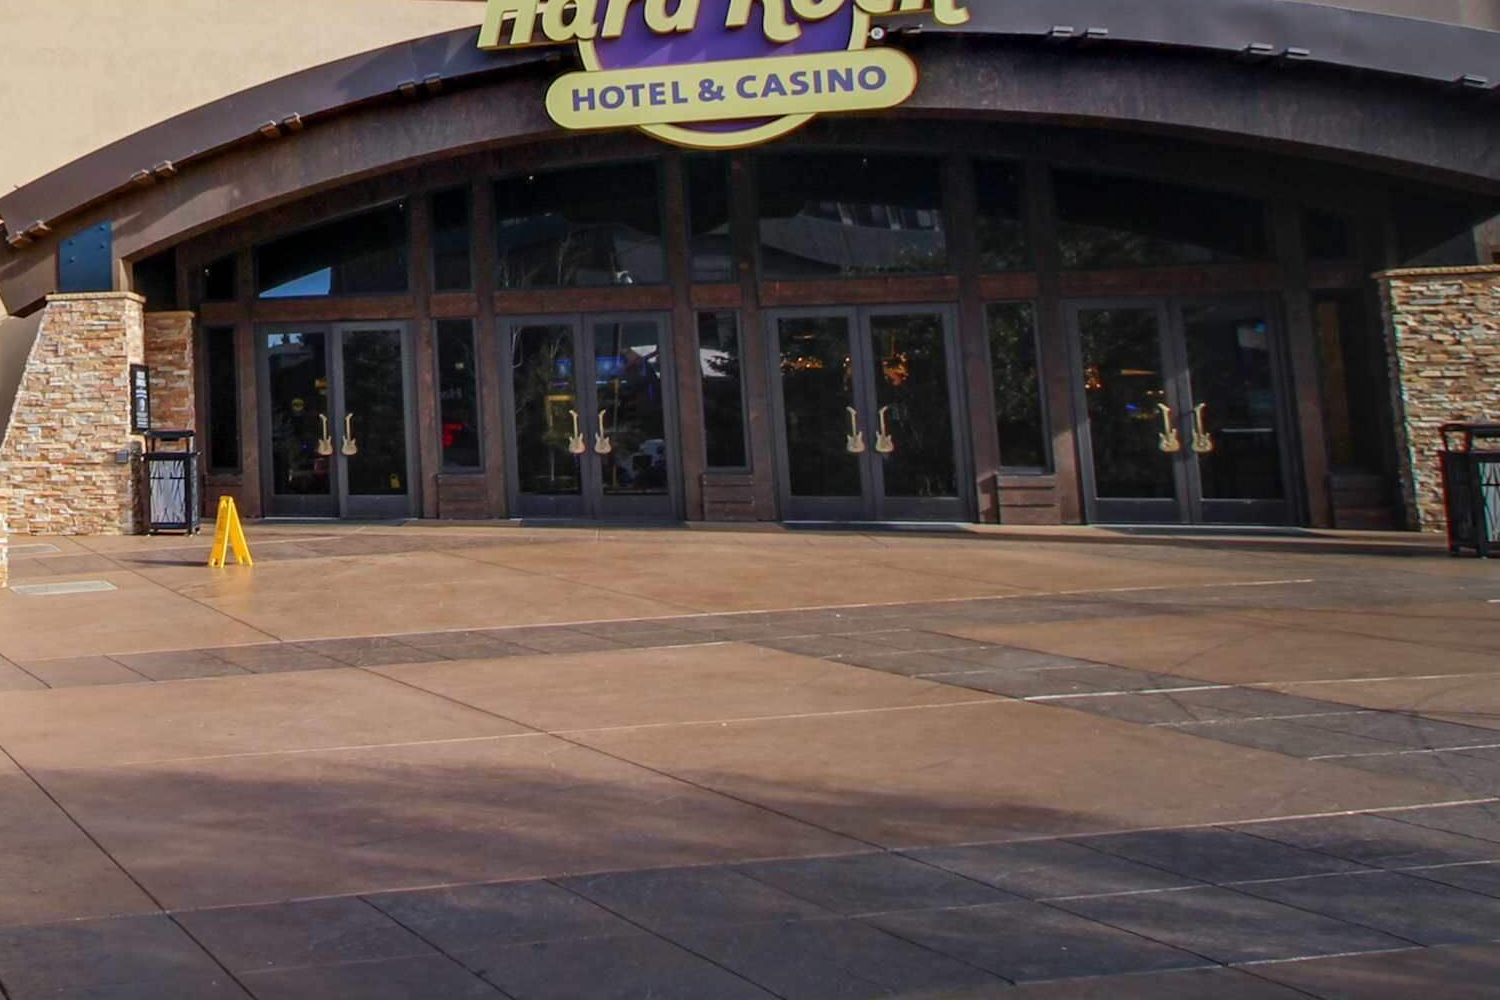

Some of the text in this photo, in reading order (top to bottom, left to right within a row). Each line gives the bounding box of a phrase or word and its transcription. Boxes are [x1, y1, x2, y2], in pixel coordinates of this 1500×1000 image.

[571, 64, 888, 112] HOTEL & CASINO
